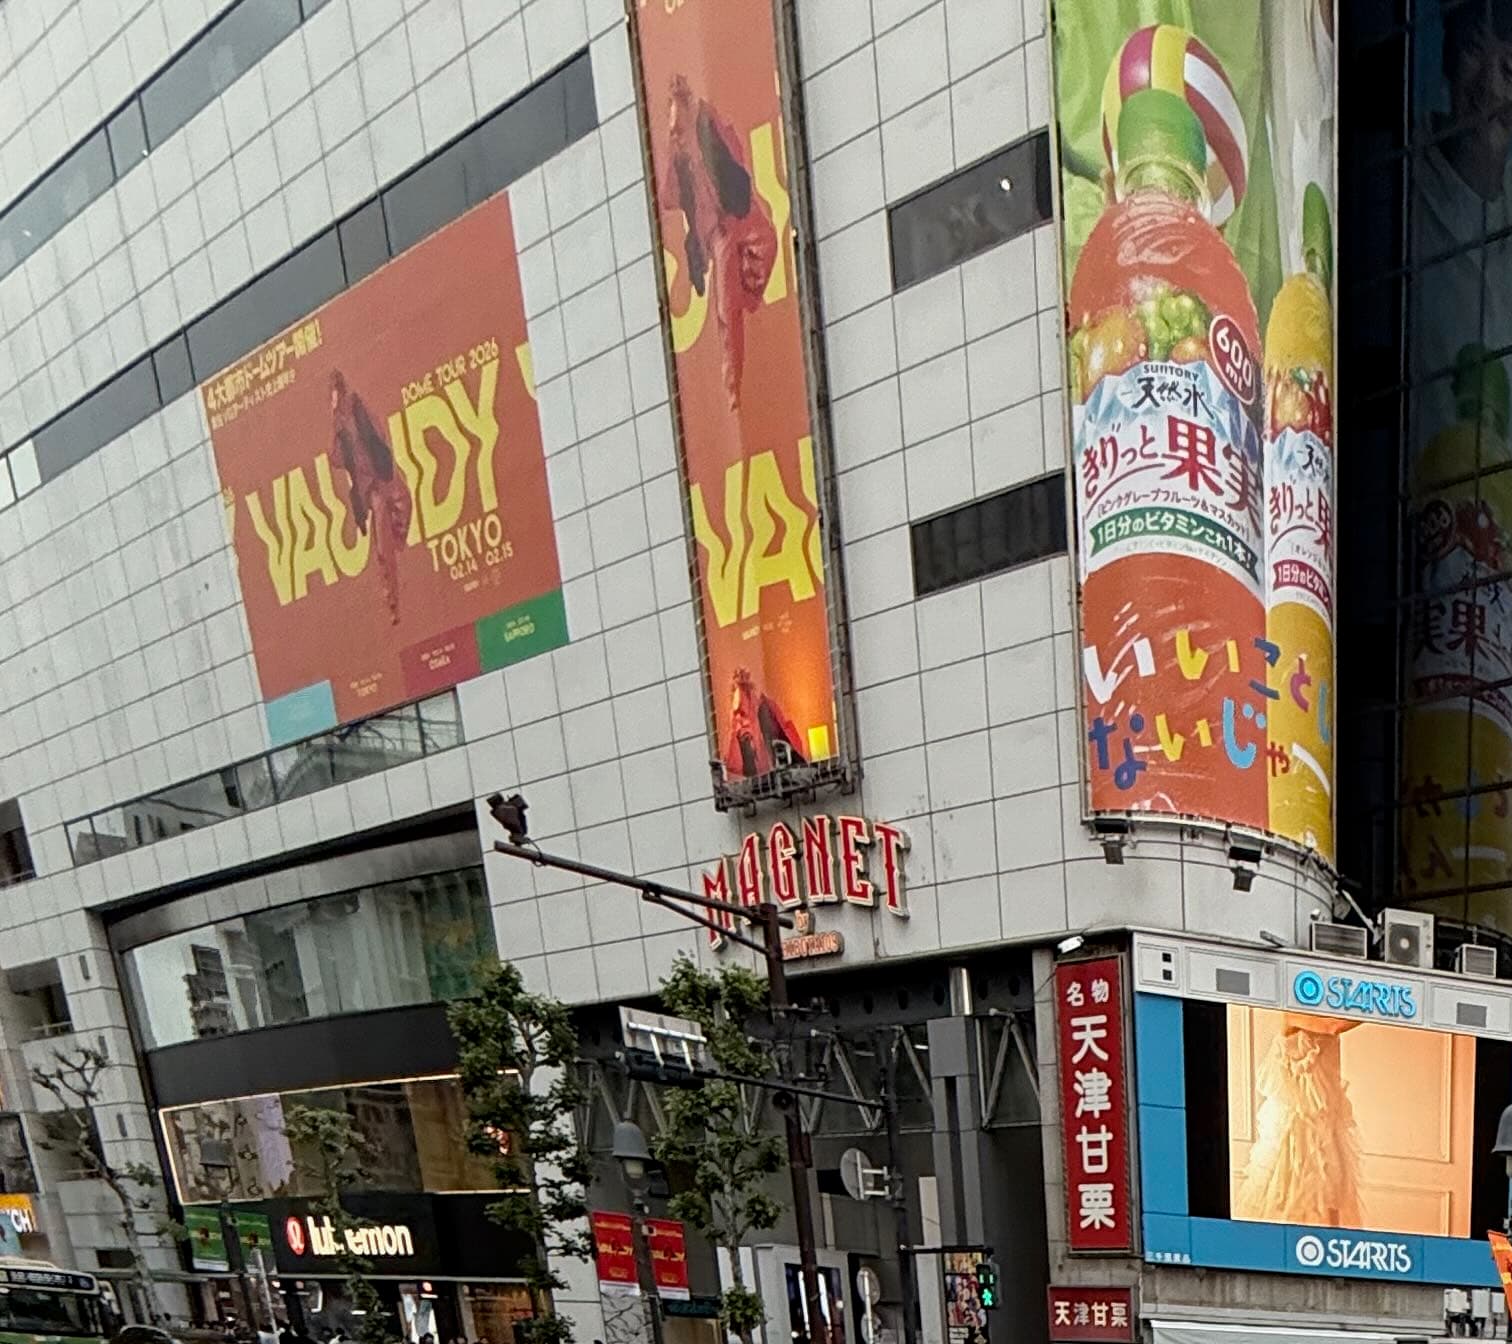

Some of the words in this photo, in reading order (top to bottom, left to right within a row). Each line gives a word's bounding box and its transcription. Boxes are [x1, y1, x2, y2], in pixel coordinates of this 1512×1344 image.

[401, 372, 434, 407] DOME
[435, 355, 467, 385] TOUR
[468, 337, 499, 370] 2026
[1216, 326, 1253, 389] 600
[427, 513, 502, 572] TOKYO
[702, 814, 911, 951] MAGNET
[1066, 978, 1110, 1008] 名物
[1327, 976, 1417, 1019] STARTS
[1070, 1014, 1117, 1231] 天津甘栗
[1326, 1238, 1412, 1273] STARTS
[1054, 1300, 1128, 1328] 天津甘栗
